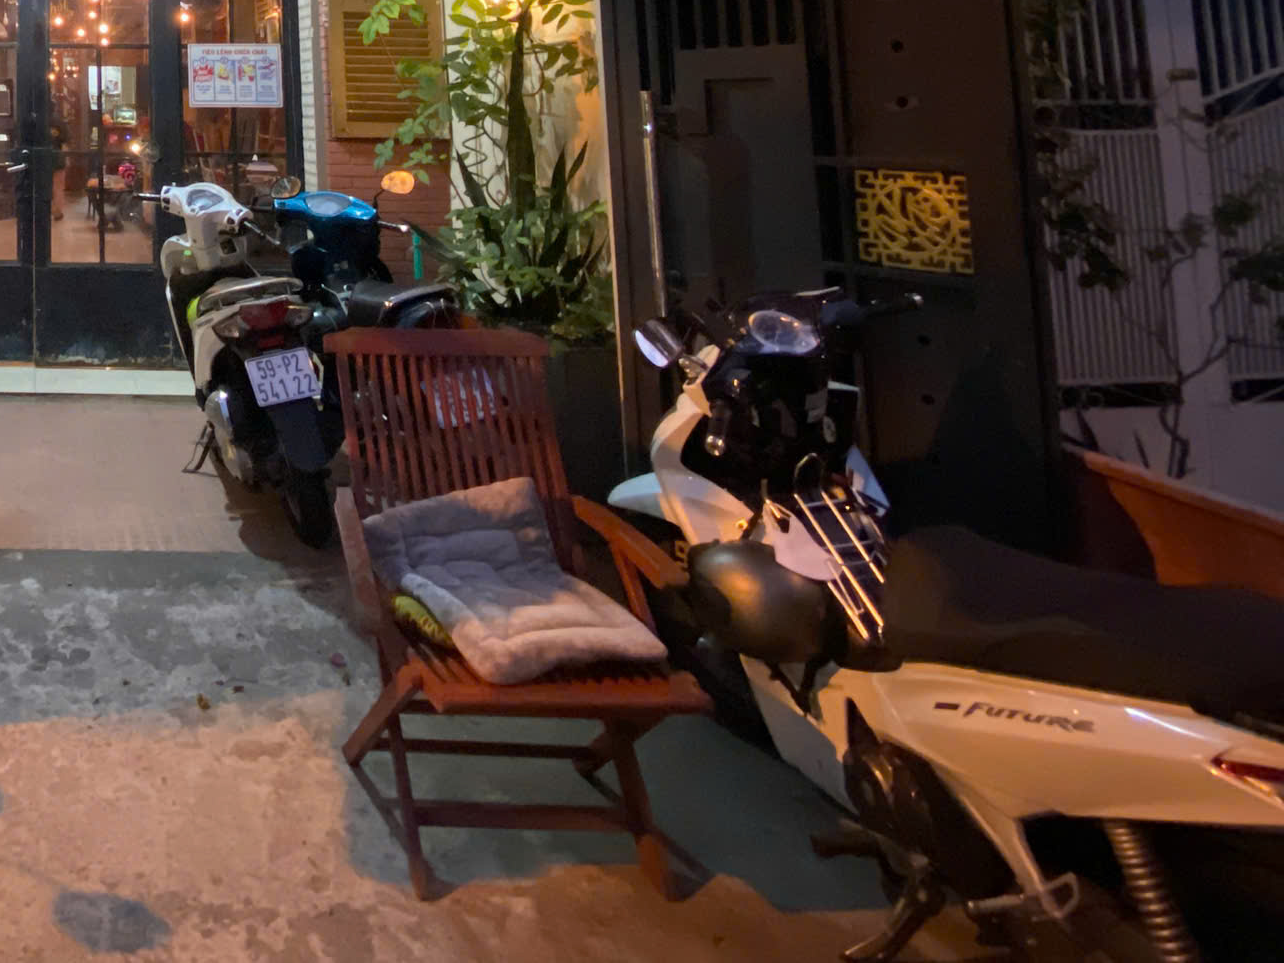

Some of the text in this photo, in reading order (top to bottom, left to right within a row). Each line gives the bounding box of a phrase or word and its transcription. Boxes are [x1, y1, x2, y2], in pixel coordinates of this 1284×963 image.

[256, 353, 303, 380] 59-P2
[258, 373, 316, 402] 541.22
[963, 701, 1095, 733] FUTURE
